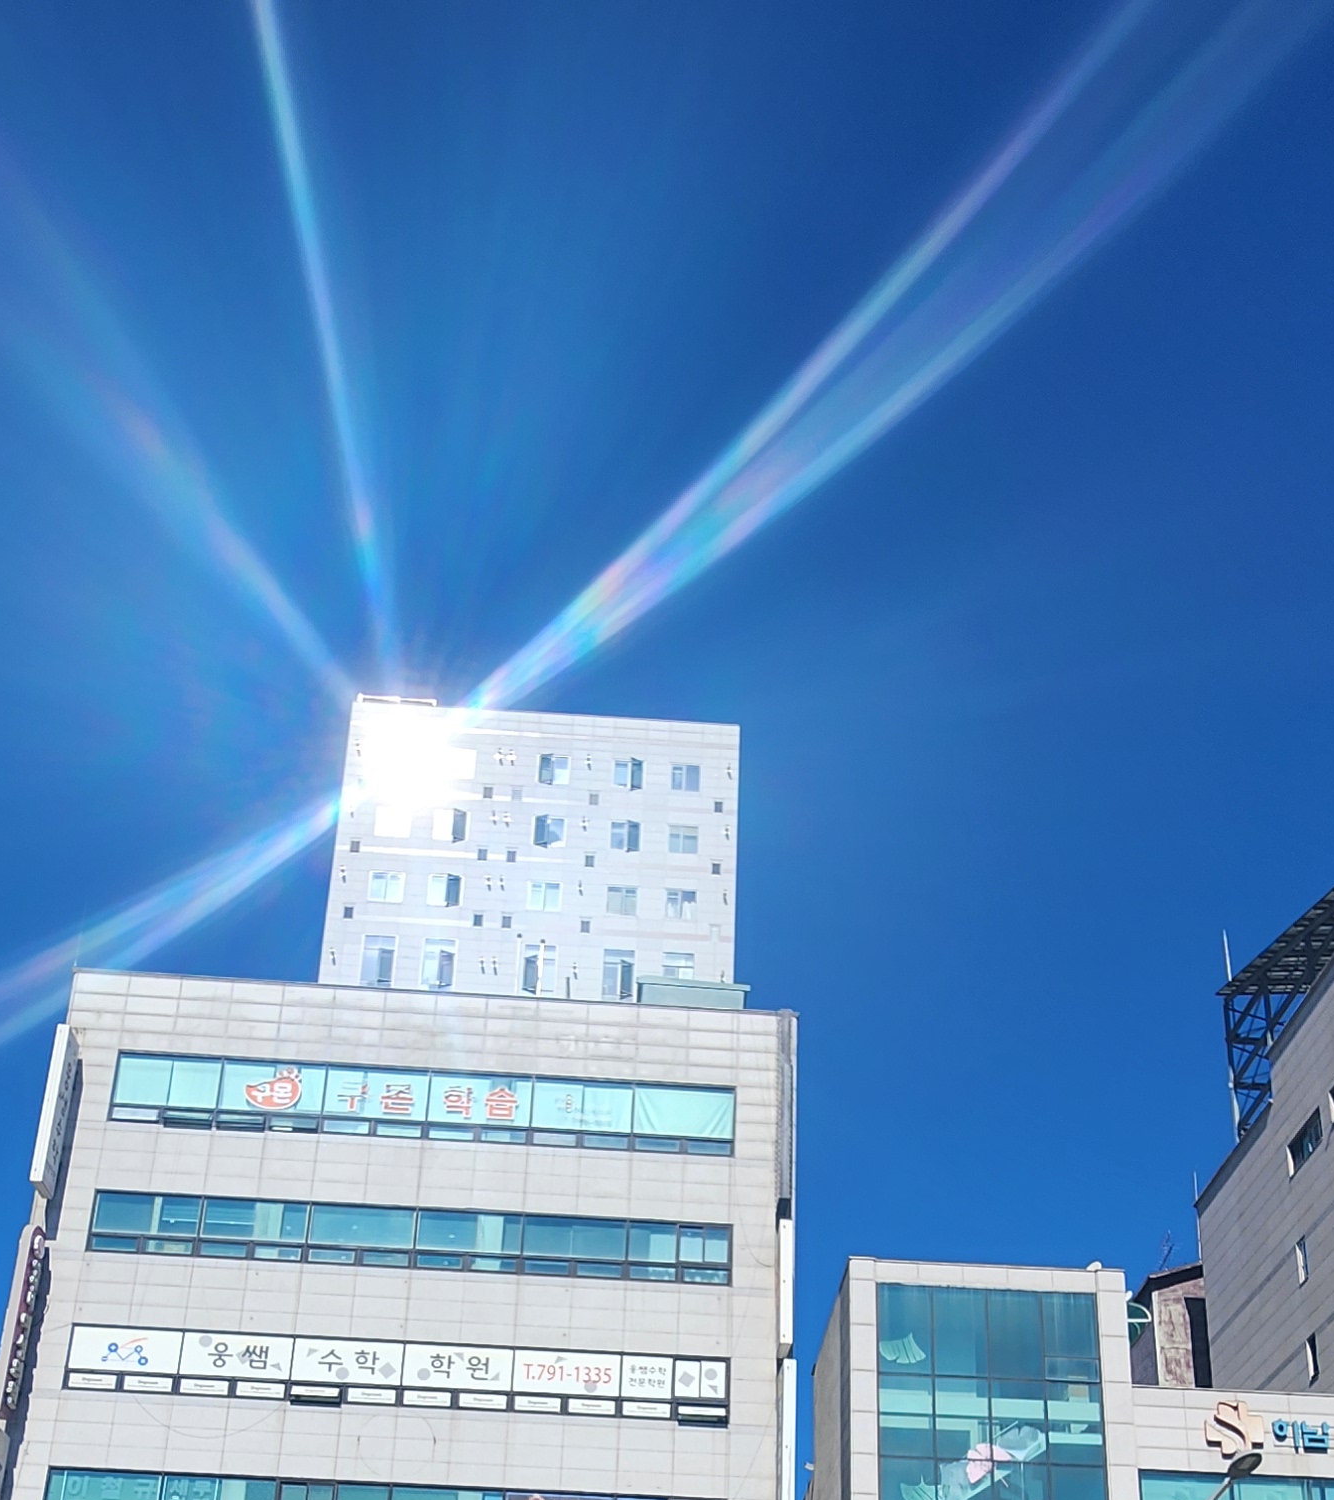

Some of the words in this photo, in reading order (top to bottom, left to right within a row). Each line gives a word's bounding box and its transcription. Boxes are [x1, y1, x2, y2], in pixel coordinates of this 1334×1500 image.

[208, 1342, 270, 1370] 웅쌤
[318, 1348, 380, 1375] 수학
[430, 1353, 490, 1381] 학원
[523, 1363, 612, 1384] T.791-1335
